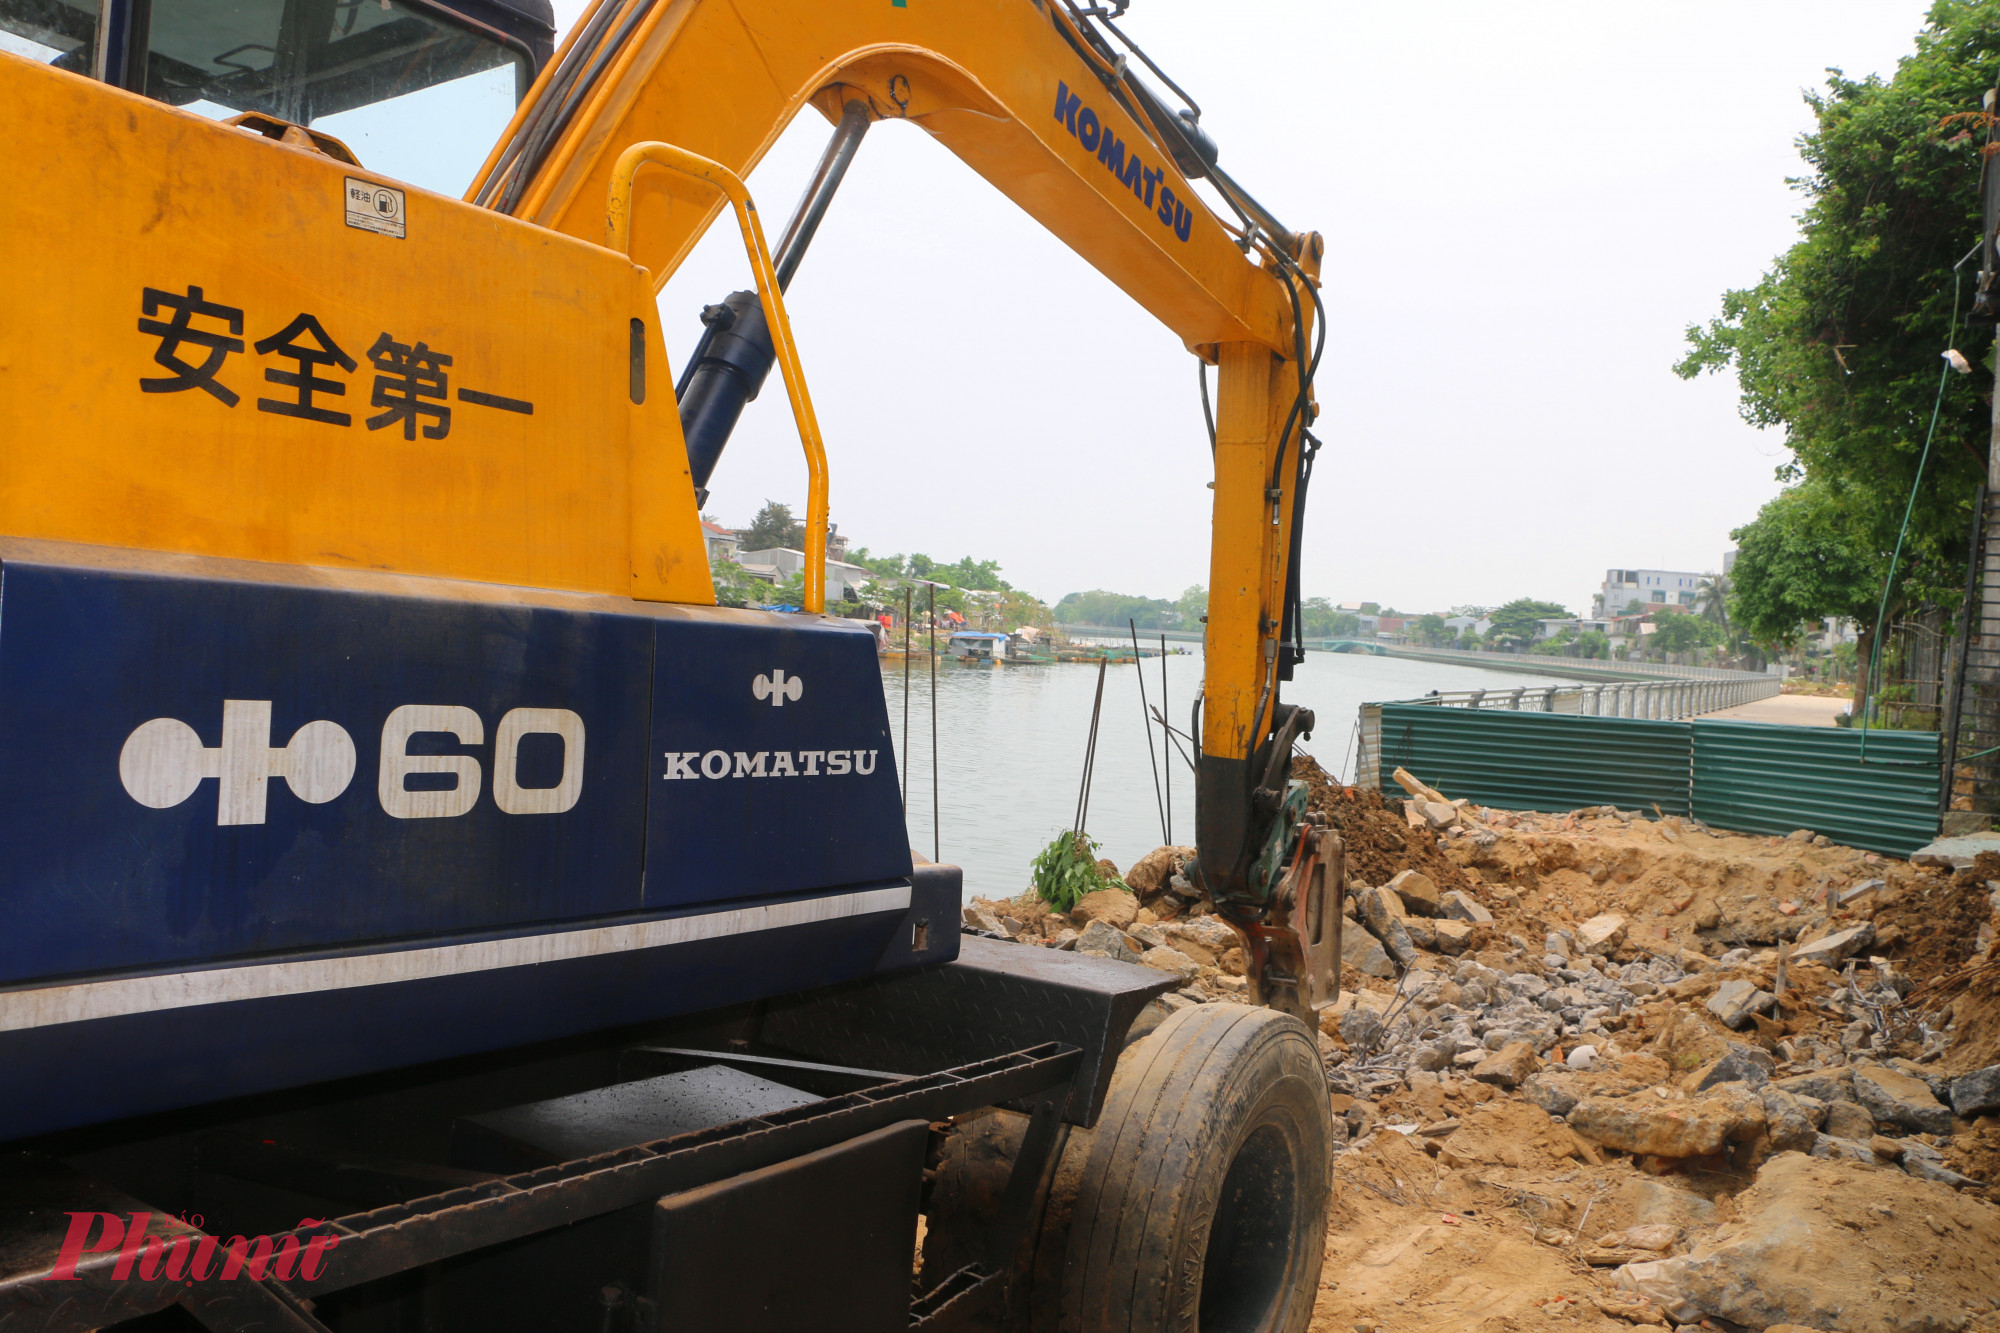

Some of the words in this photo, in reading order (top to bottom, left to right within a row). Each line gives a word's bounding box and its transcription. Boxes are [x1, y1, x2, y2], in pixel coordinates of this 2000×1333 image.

[350, 188, 370, 203] 軽油
[1054, 79, 1193, 242] KOMATSU
[138, 285, 534, 441] 安全第一
[378, 704, 586, 819] 60
[663, 750, 878, 780] KOMATSU
